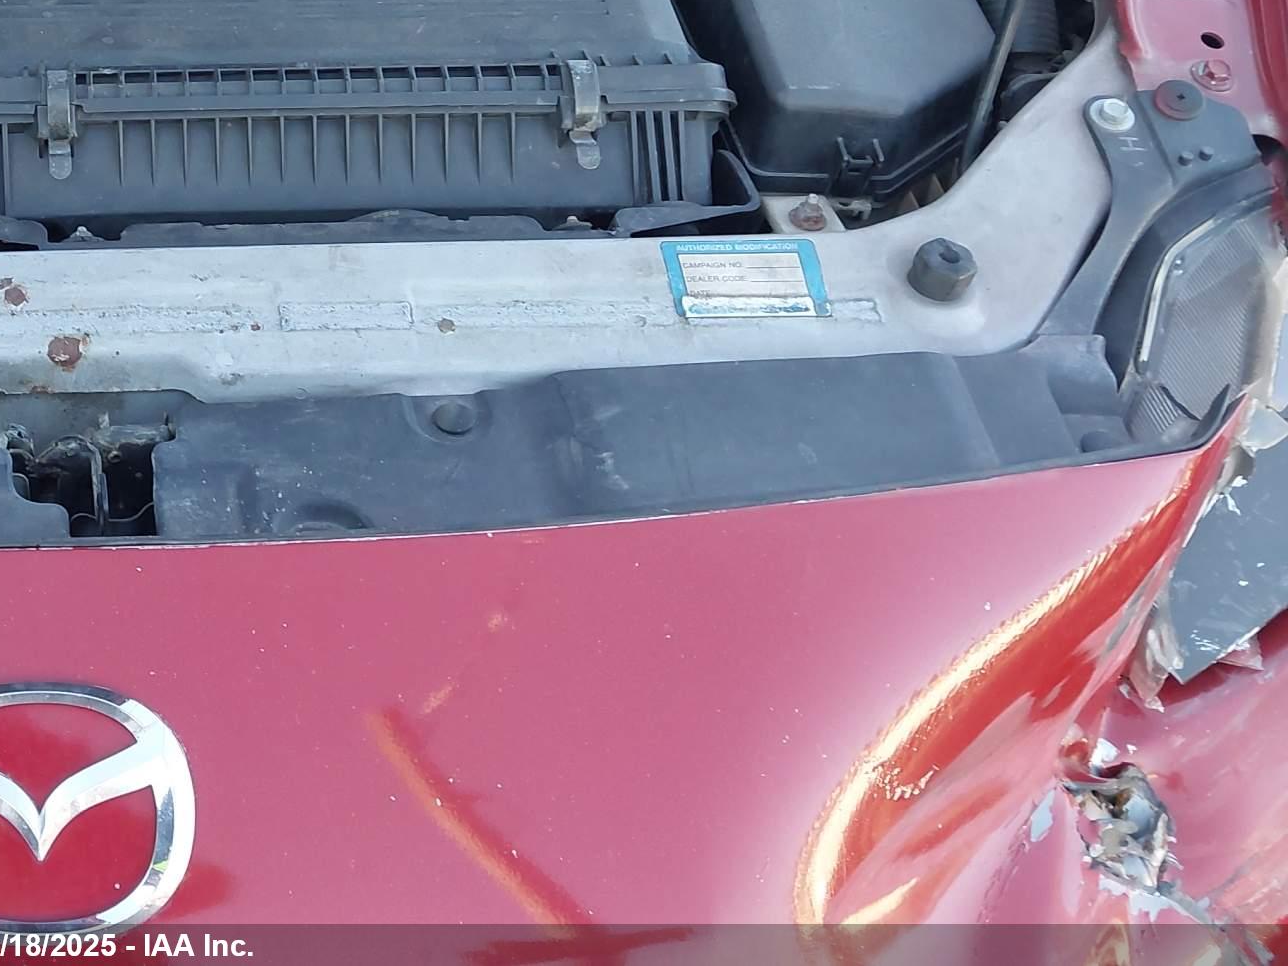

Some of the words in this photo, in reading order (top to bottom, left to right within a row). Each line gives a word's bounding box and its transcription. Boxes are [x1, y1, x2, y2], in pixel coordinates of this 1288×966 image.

[676, 243, 733, 251] AUTHORIZED
[734, 242, 798, 251] MODIFICATION
[682, 261, 726, 269] CAMPAIGN
[686, 275, 719, 283] DEALER
